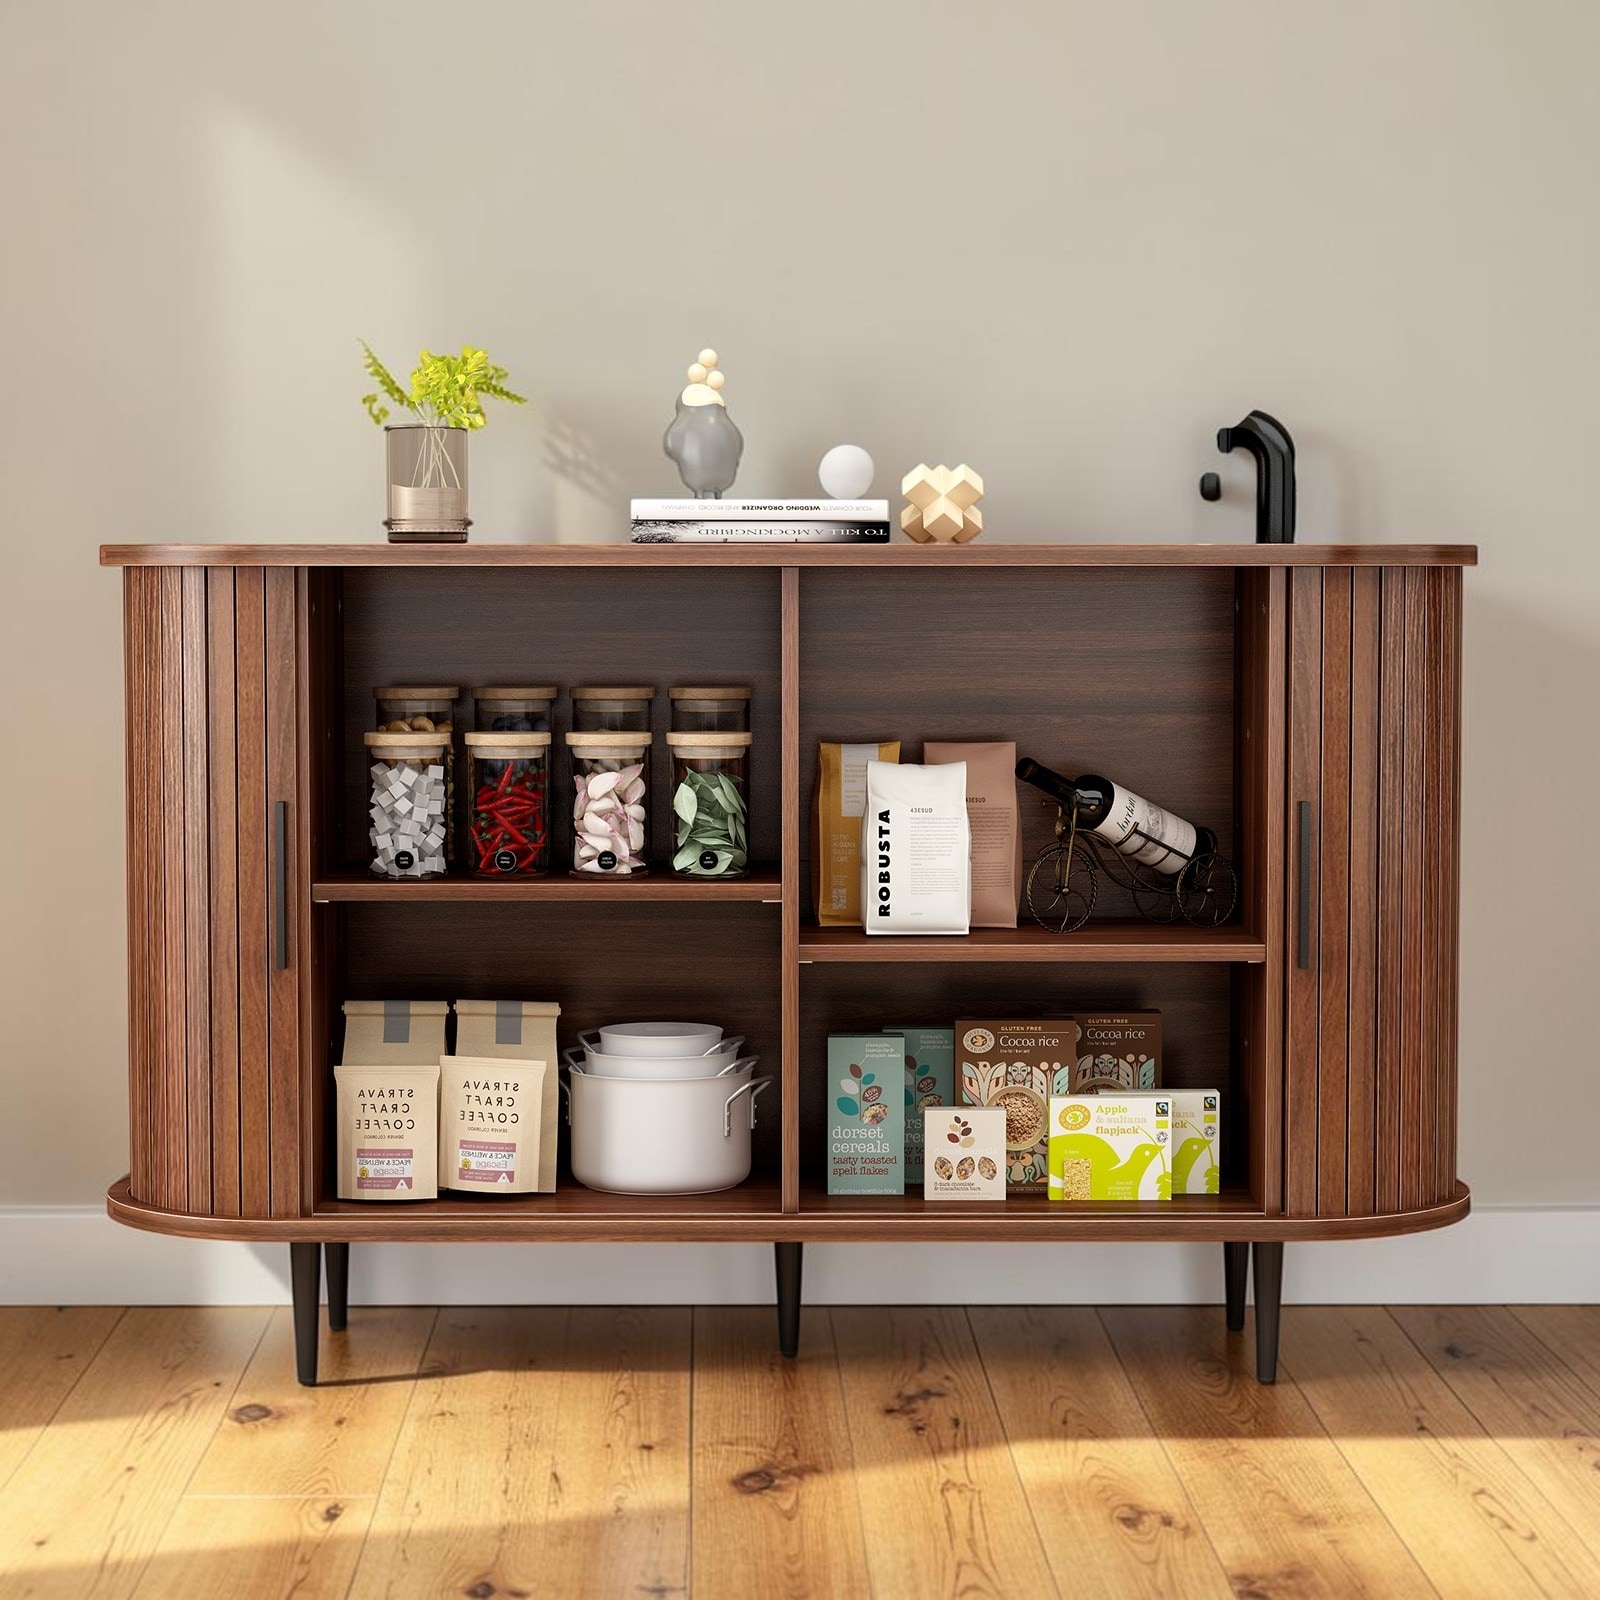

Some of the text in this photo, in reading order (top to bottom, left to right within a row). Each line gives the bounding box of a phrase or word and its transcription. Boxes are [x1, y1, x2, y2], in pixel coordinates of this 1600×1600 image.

[878, 809, 890, 917] ROBUSTA
[1086, 1028, 1145, 1039] Cocoa rice
[999, 1035, 1059, 1047] Cocoa rice
[1096, 1105, 1127, 1115] Apple
[1096, 1115, 1147, 1123] & sultana
[832, 1126, 884, 1139] dorset
[1095, 1126, 1139, 1136] flapjack
[832, 1140, 890, 1153] cereals
[833, 1156, 859, 1166] tasty
[860, 1155, 897, 1165] toasted
[832, 1166, 889, 1176] spelt flakes
